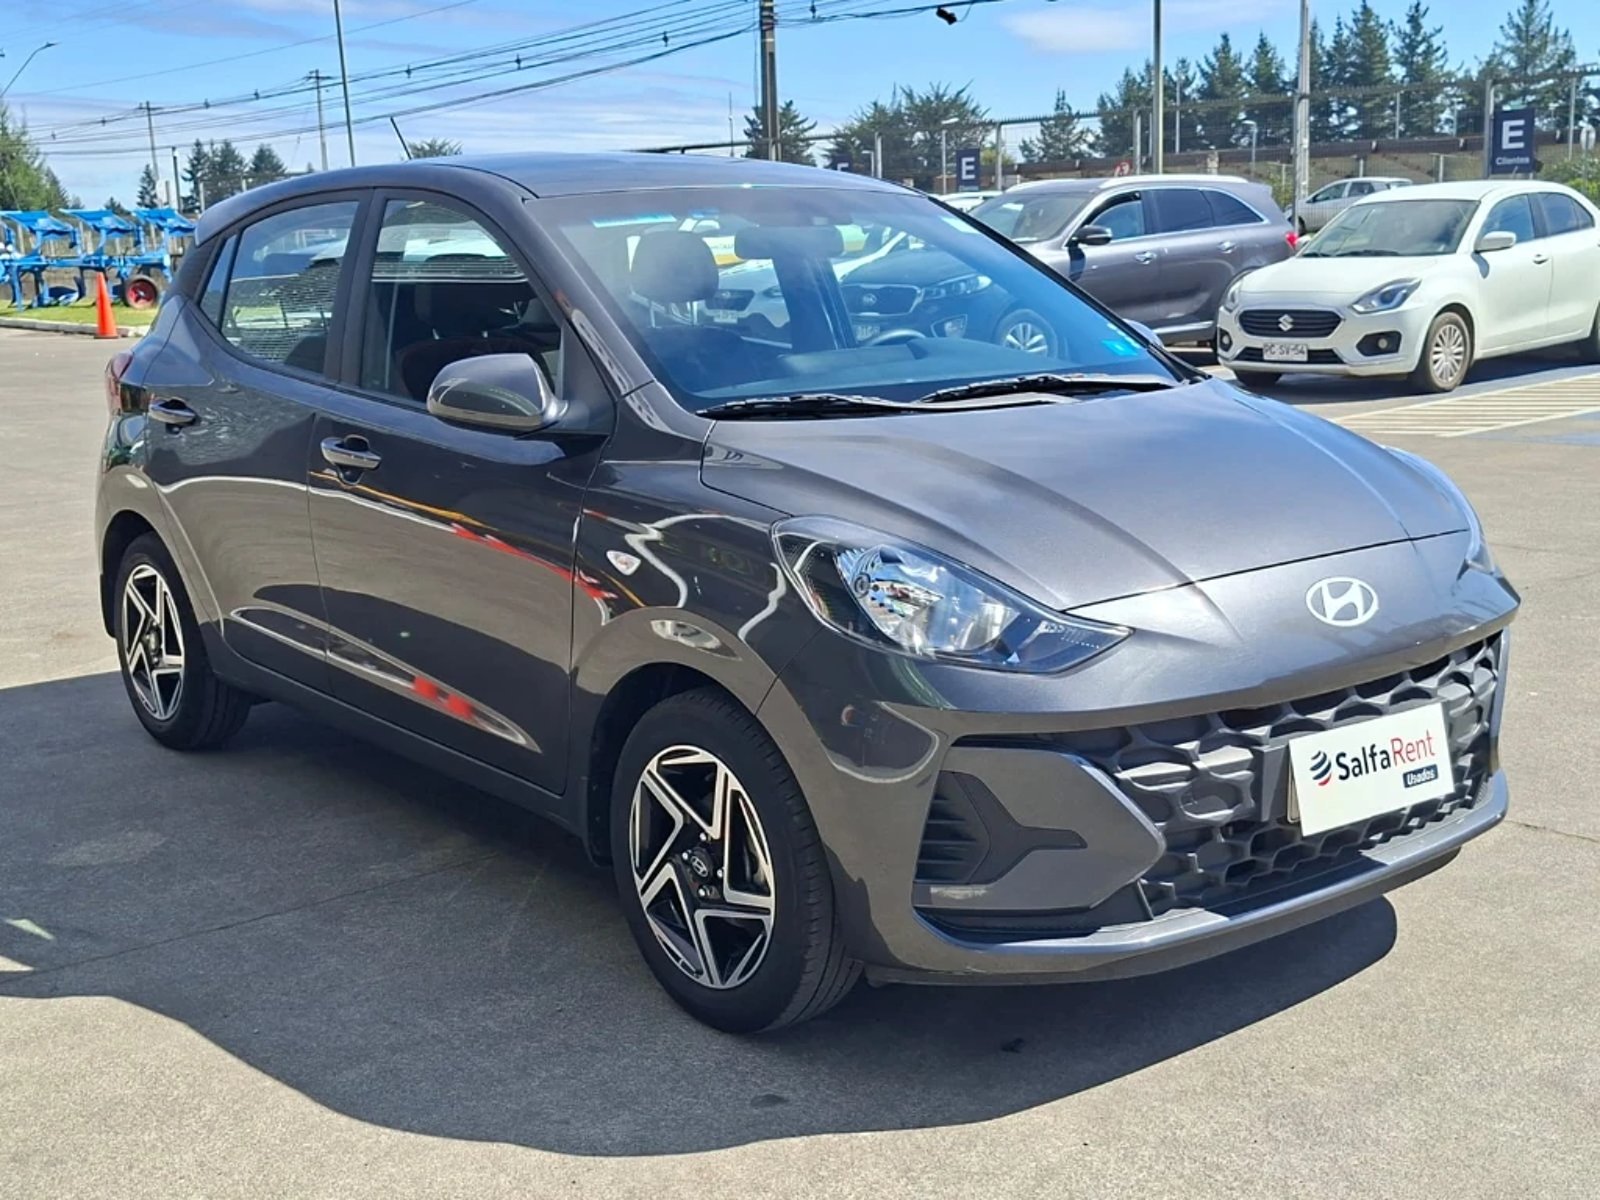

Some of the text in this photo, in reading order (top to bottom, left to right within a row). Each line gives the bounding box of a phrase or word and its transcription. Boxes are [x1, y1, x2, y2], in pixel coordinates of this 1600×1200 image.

[1502, 119, 1525, 150] E
[961, 157, 975, 180] E
[1335, 729, 1435, 780] SalfaRent
